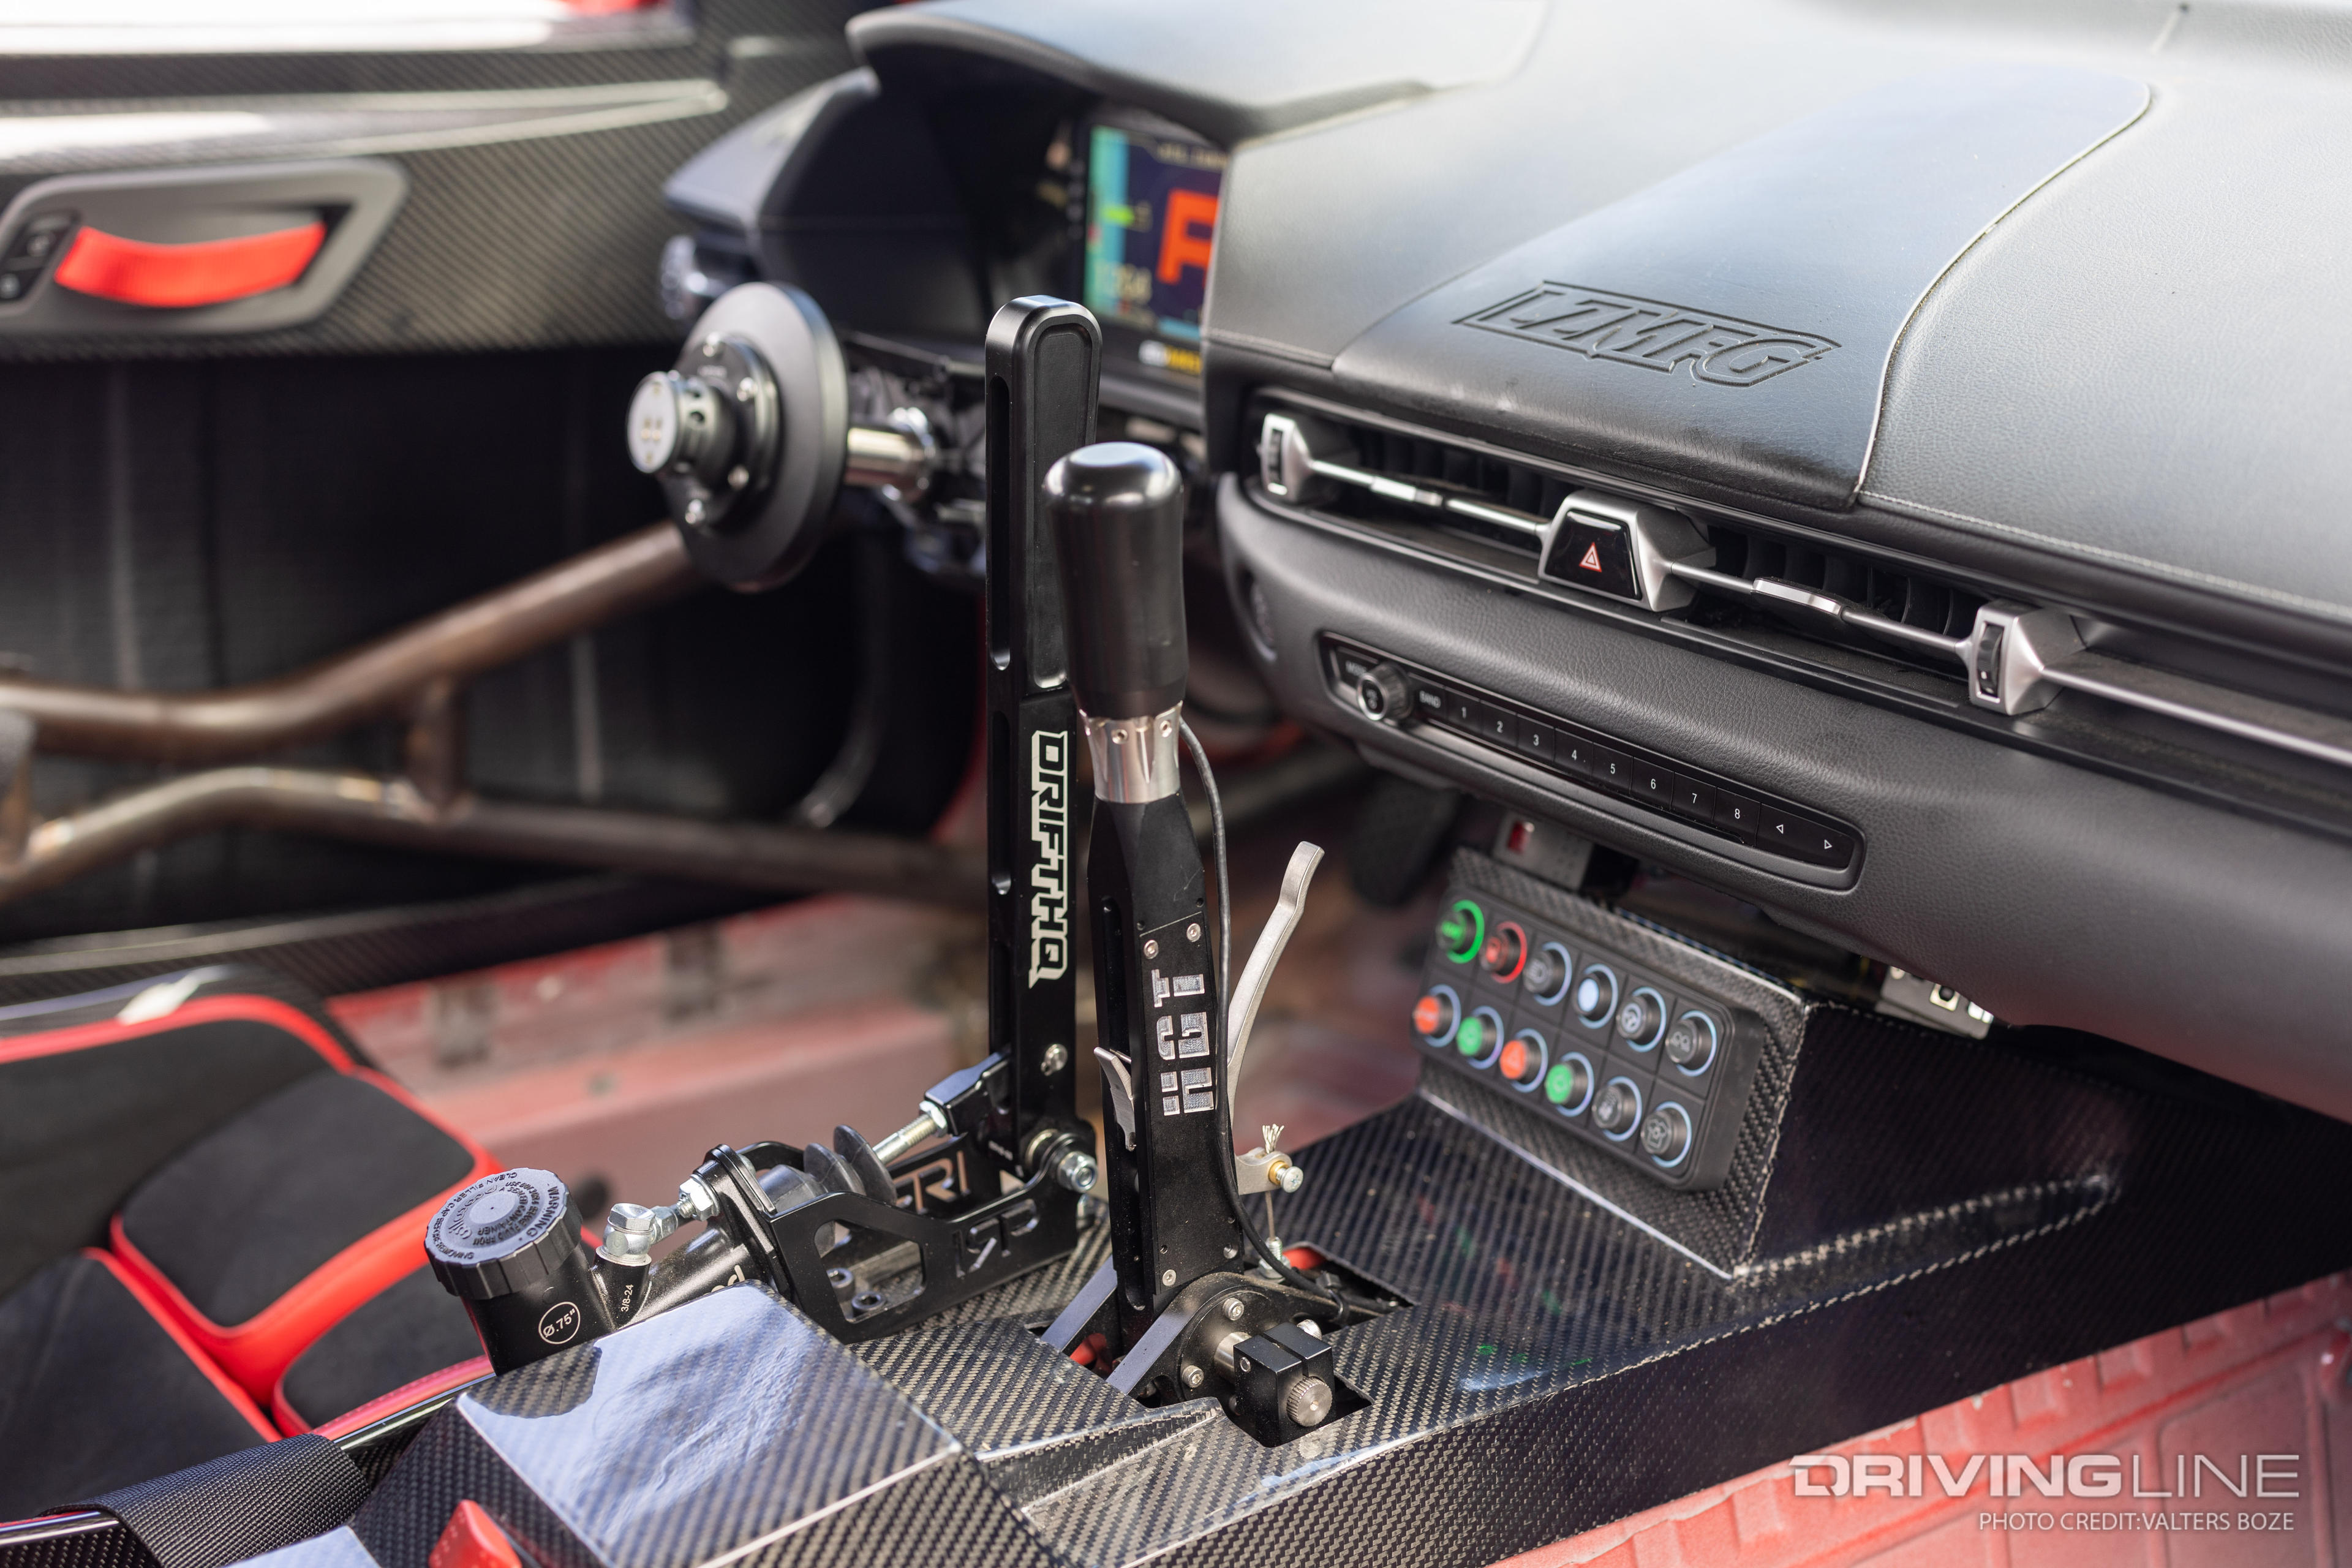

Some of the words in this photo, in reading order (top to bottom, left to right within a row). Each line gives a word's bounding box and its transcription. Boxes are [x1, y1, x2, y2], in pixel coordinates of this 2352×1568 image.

[1461, 707, 1466, 718] 1
[1497, 721, 1503, 733] 2
[1533, 734, 1539, 746] 3
[1571, 749, 1577, 760] 4
[1610, 763, 1616, 774] 5
[1651, 778, 1656, 790] 6
[1692, 793, 1697, 804] 7
[1735, 808, 1740, 820] 8
[486, 1172, 518, 1185] CLEAN
[441, 1202, 455, 1217] CAP
[527, 1186, 560, 1237] WARNING
[620, 1284, 634, 1312] 3/8-24
